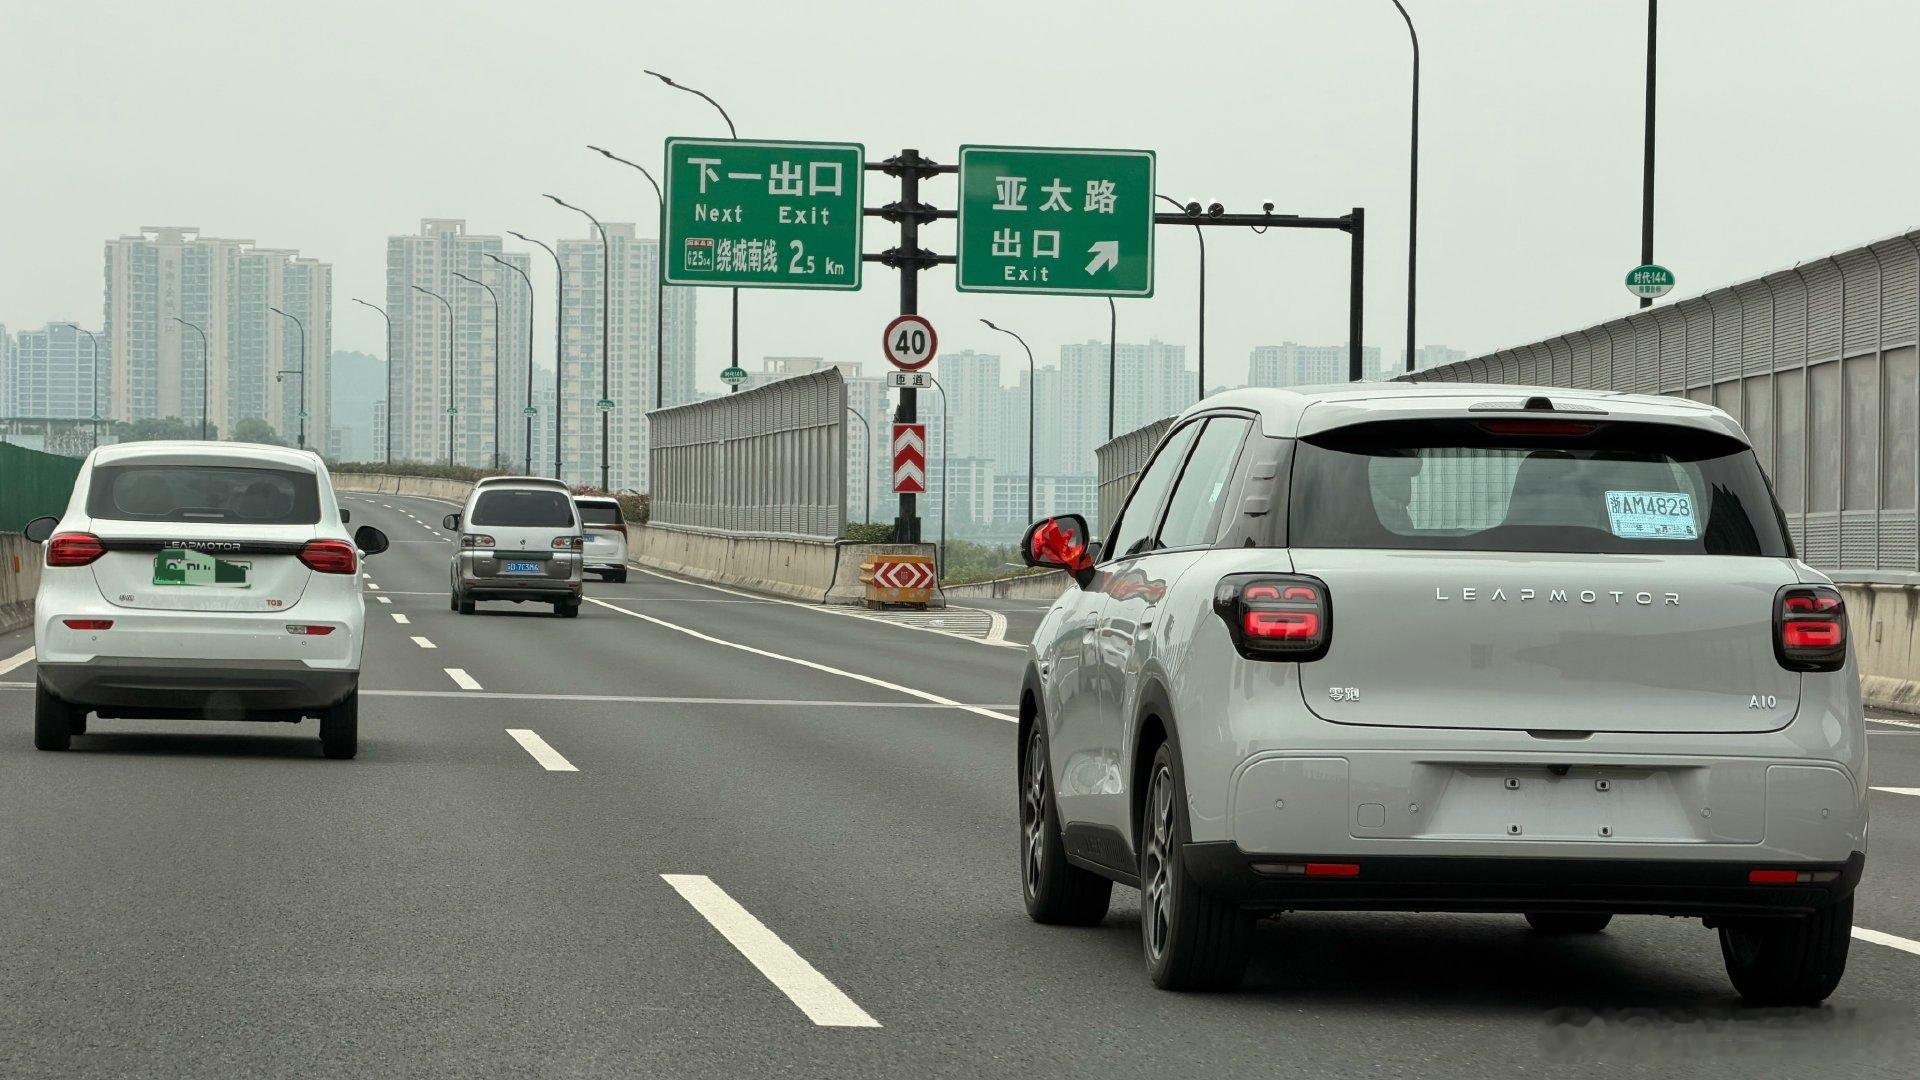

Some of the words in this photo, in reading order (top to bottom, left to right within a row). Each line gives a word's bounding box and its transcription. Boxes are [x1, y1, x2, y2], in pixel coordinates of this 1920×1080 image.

[687, 157, 843, 197] 下一出口
[992, 175, 1118, 214] 亚太路
[695, 203, 743, 223] Next
[779, 206, 829, 226] Exit
[991, 227, 1061, 259] 出口
[716, 238, 778, 273] 绕城南线
[1004, 265, 1049, 282] Exit
[894, 329, 927, 356] 40
[895, 373, 924, 386] 匝道
[1610, 495, 1690, 517] 浙AM4828
[164, 540, 241, 551] LEAPMOTOR
[1436, 586, 1680, 606] LEAPMOTOR
[1329, 687, 1360, 701] 零跑
[1748, 694, 1777, 710] A10
